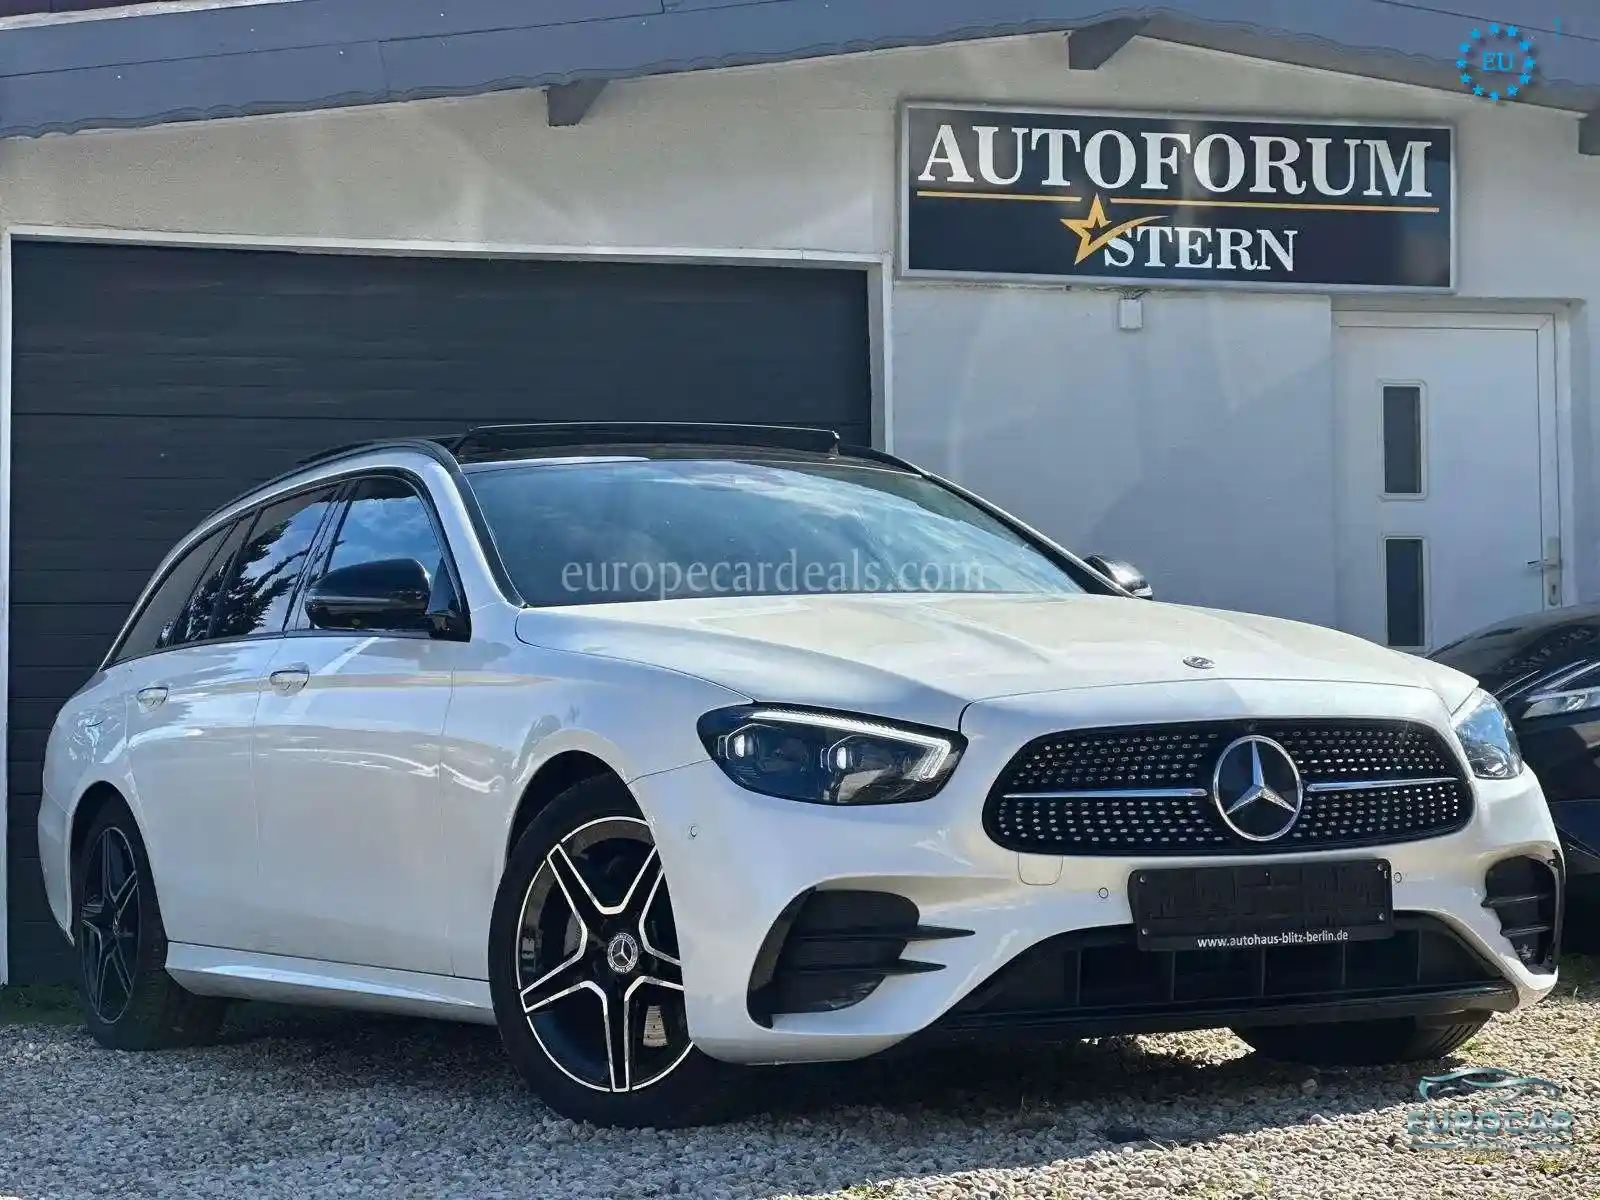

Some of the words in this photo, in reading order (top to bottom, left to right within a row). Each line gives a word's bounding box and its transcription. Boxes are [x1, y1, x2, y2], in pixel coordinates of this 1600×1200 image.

[917, 124, 1433, 198] AUTOFORUM
[1104, 225, 1298, 272] STERN
[1197, 929, 1349, 948] www.autohaus-blitz-berlin.de
